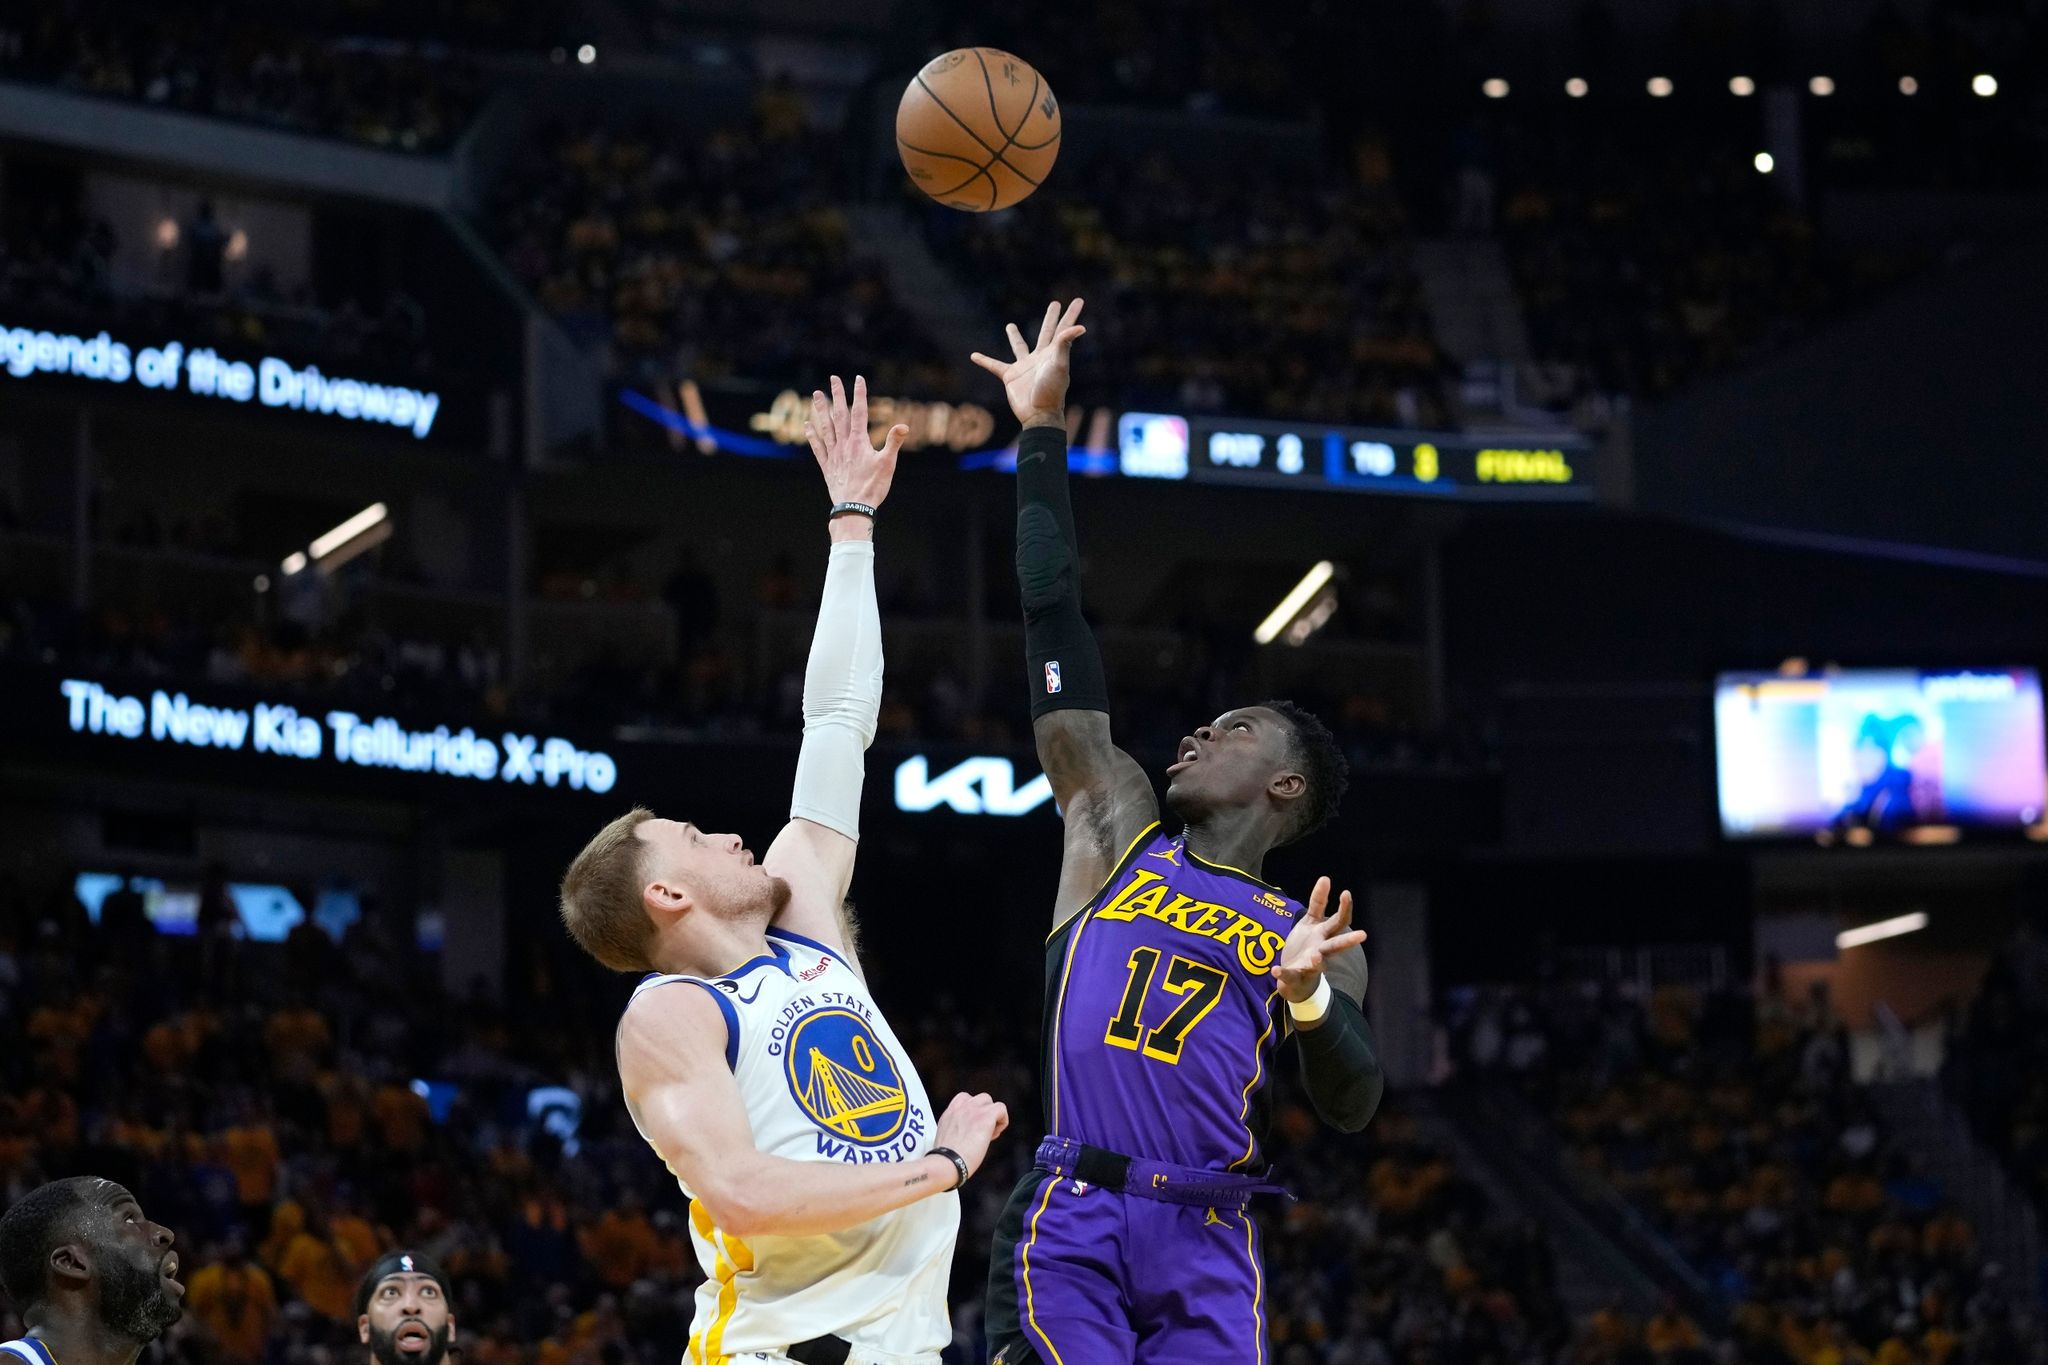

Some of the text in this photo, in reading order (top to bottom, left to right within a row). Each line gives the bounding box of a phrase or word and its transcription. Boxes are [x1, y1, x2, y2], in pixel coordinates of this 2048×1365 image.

[135, 341, 184, 388] of
[186, 348, 256, 402] the
[259, 357, 440, 439] Driveway
[845, 503, 875, 516] Believe
[62, 679, 617, 794] The New Kia Telluride X-Pro
[1092, 868, 1286, 976] LAKERS
[1252, 894, 1293, 918] bibigo
[768, 992, 873, 1056] GOLDEN STATE
[1103, 946, 1229, 1066] 17
[852, 1034, 875, 1073] 0
[816, 1103, 924, 1165] WARRIORS
